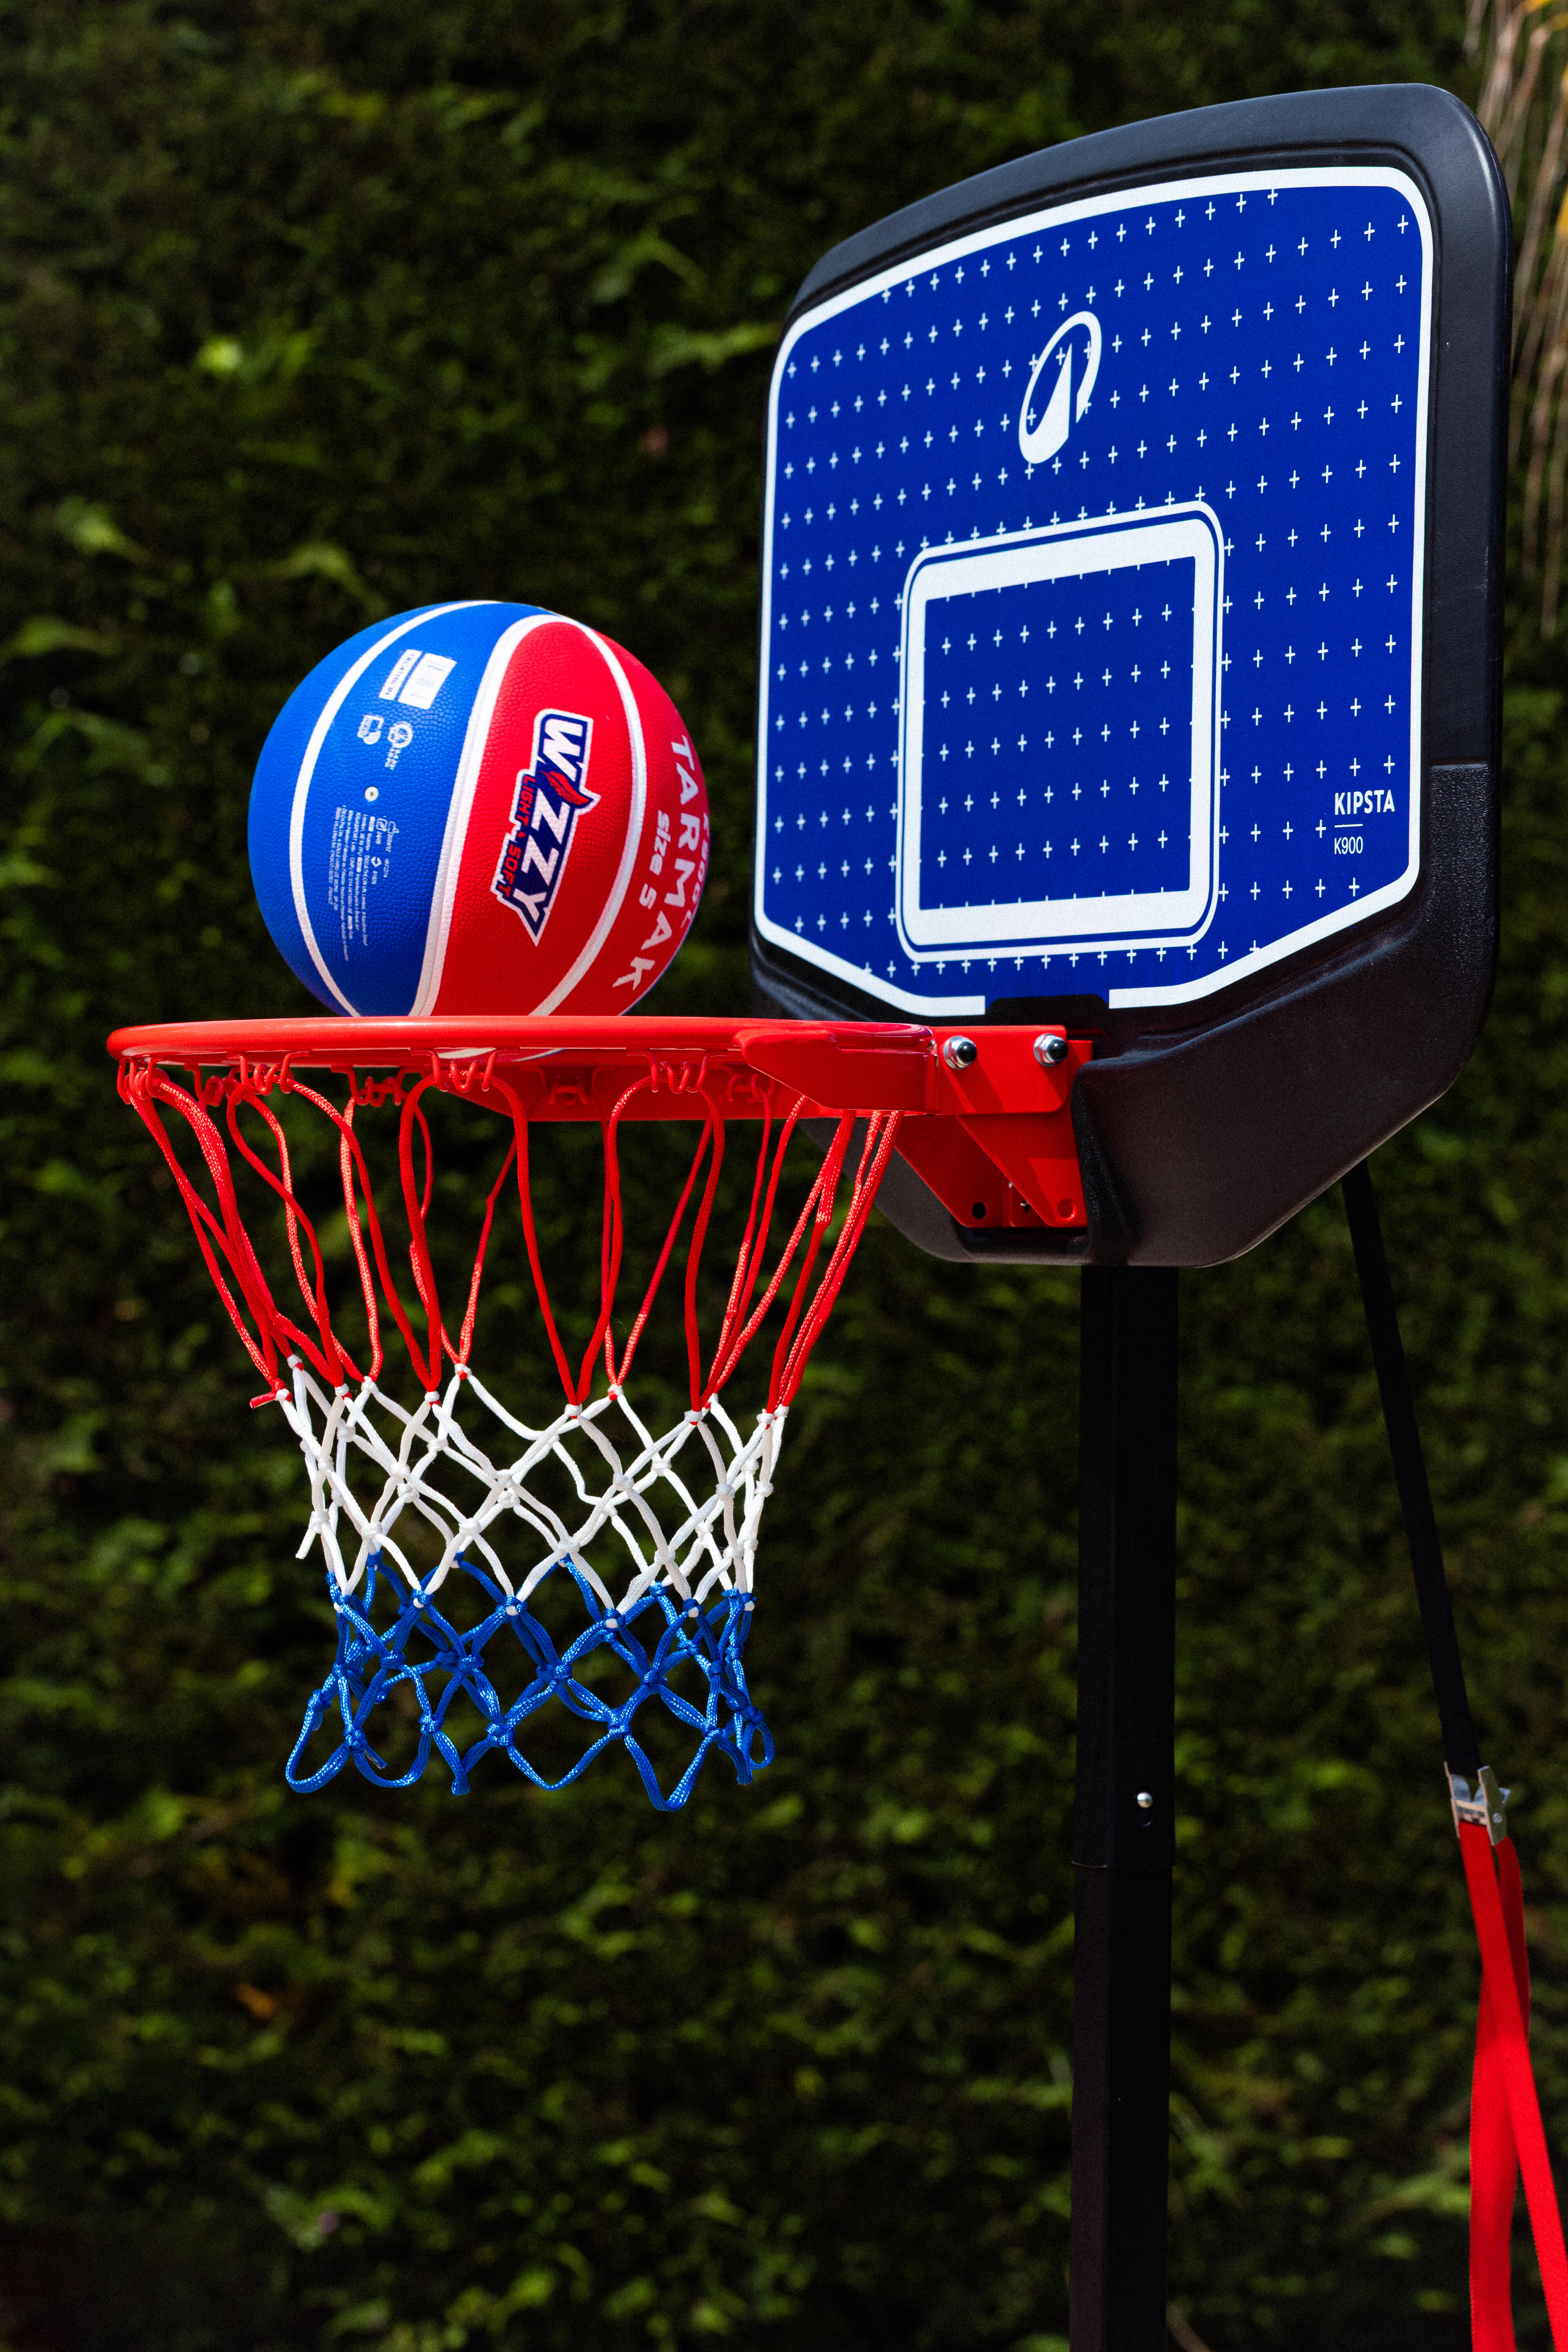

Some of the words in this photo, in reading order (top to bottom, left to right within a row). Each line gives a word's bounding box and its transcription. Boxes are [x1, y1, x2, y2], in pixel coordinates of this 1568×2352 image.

[513, 719, 593, 923] WIZZY
[516, 774, 535, 826] LIGHT
[1335, 789, 1395, 815] KIPSTA
[497, 844, 521, 898] SOFT
[612, 735, 700, 990] TARMAK
[1334, 836, 1363, 855] K900
[639, 884, 657, 909] 5
